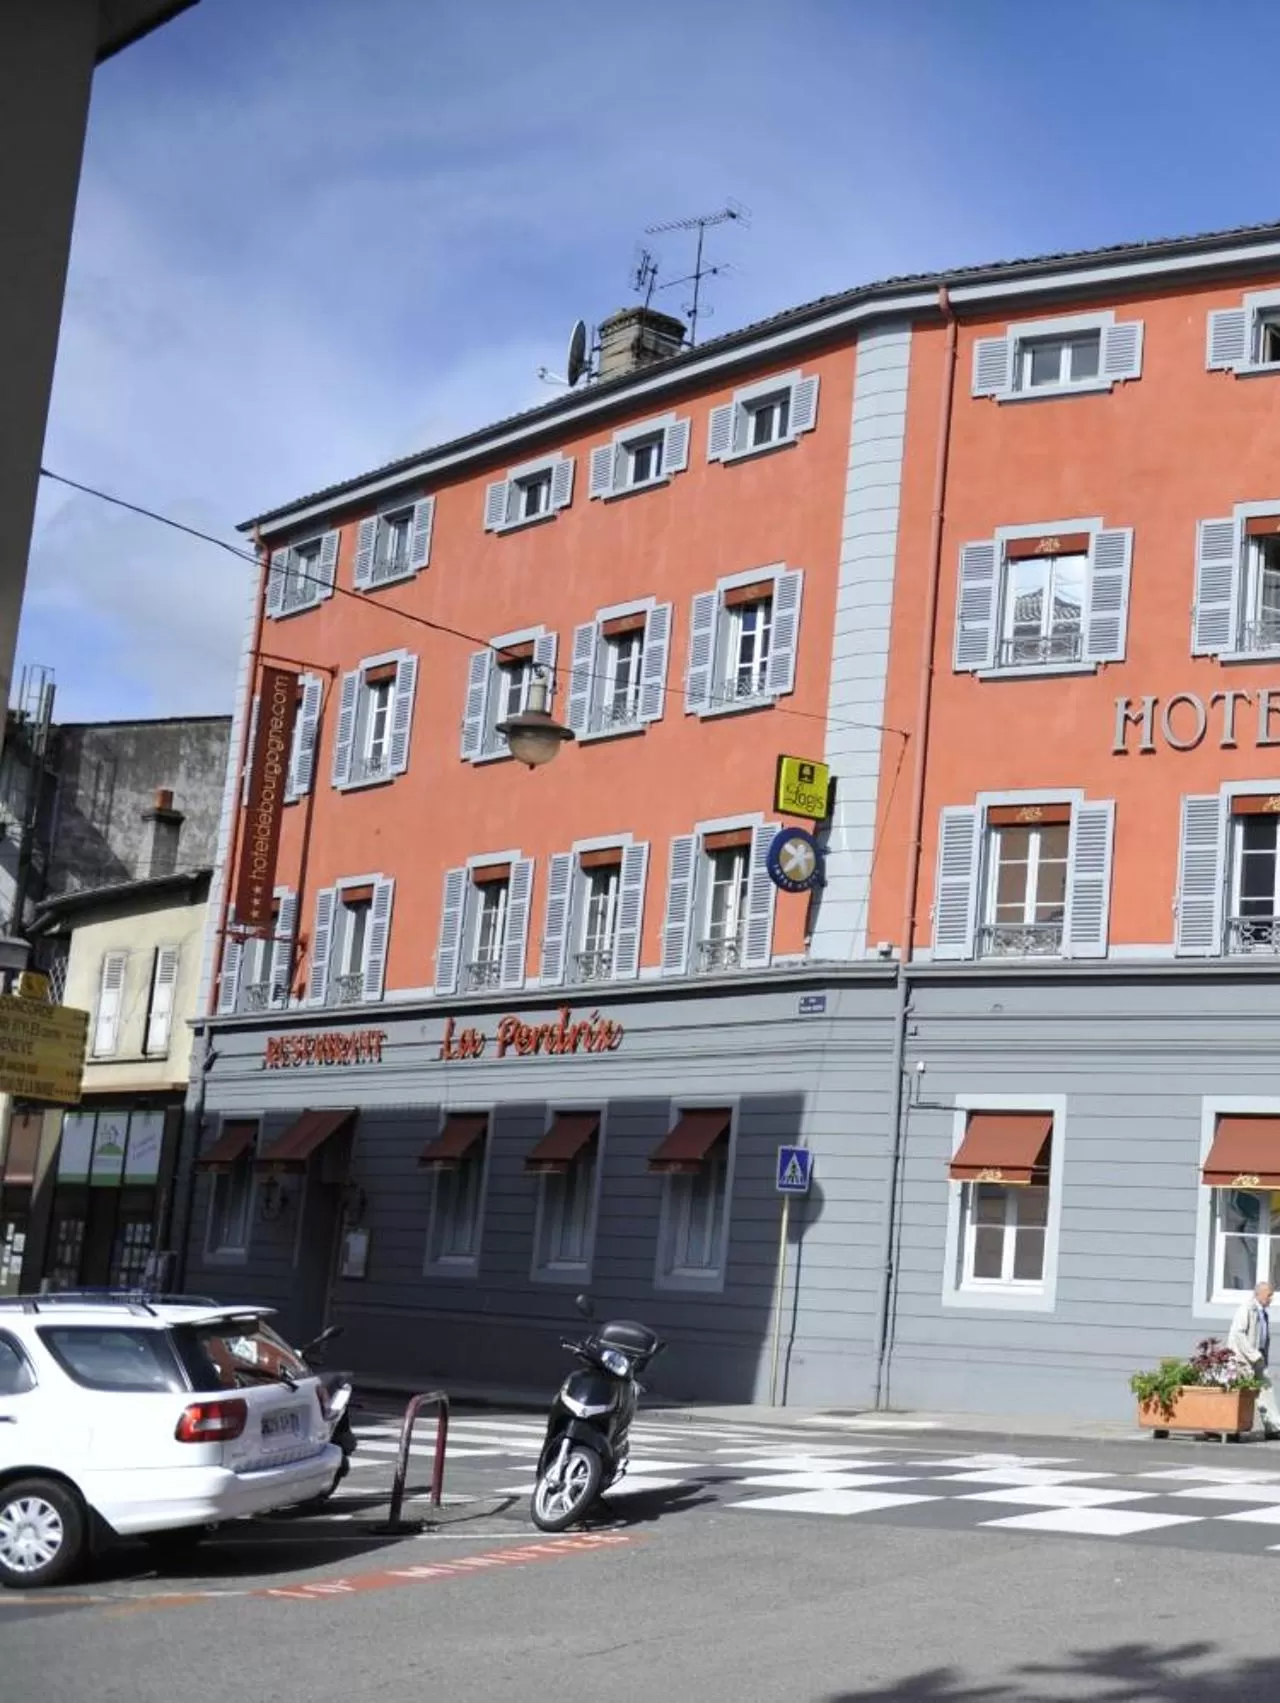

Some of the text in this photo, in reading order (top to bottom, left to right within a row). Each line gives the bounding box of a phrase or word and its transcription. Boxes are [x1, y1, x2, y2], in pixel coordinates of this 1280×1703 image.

[250, 674, 289, 880] hoteldebourgogne.com
[263, 1030, 386, 1069] RESTAURANT
[440, 1001, 624, 1061] La Perdrix
